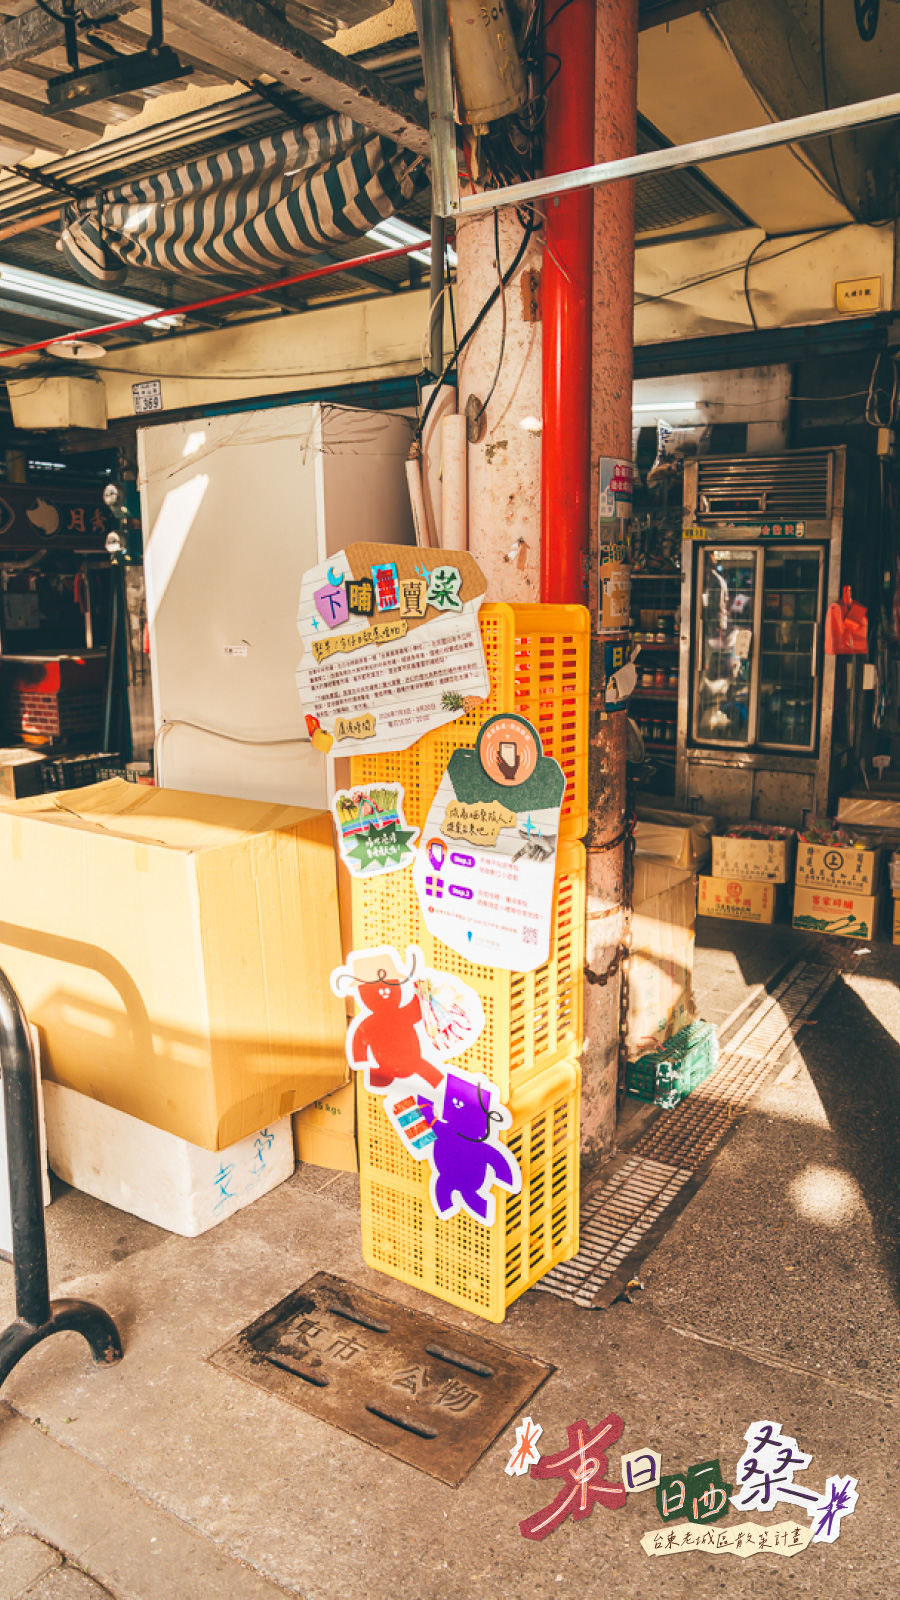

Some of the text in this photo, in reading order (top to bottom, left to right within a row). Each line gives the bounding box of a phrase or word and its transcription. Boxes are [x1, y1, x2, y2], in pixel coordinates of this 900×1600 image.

[321, 568, 460, 620] 下晡無賣菜
[325, 1103, 342, 1115] kgs
